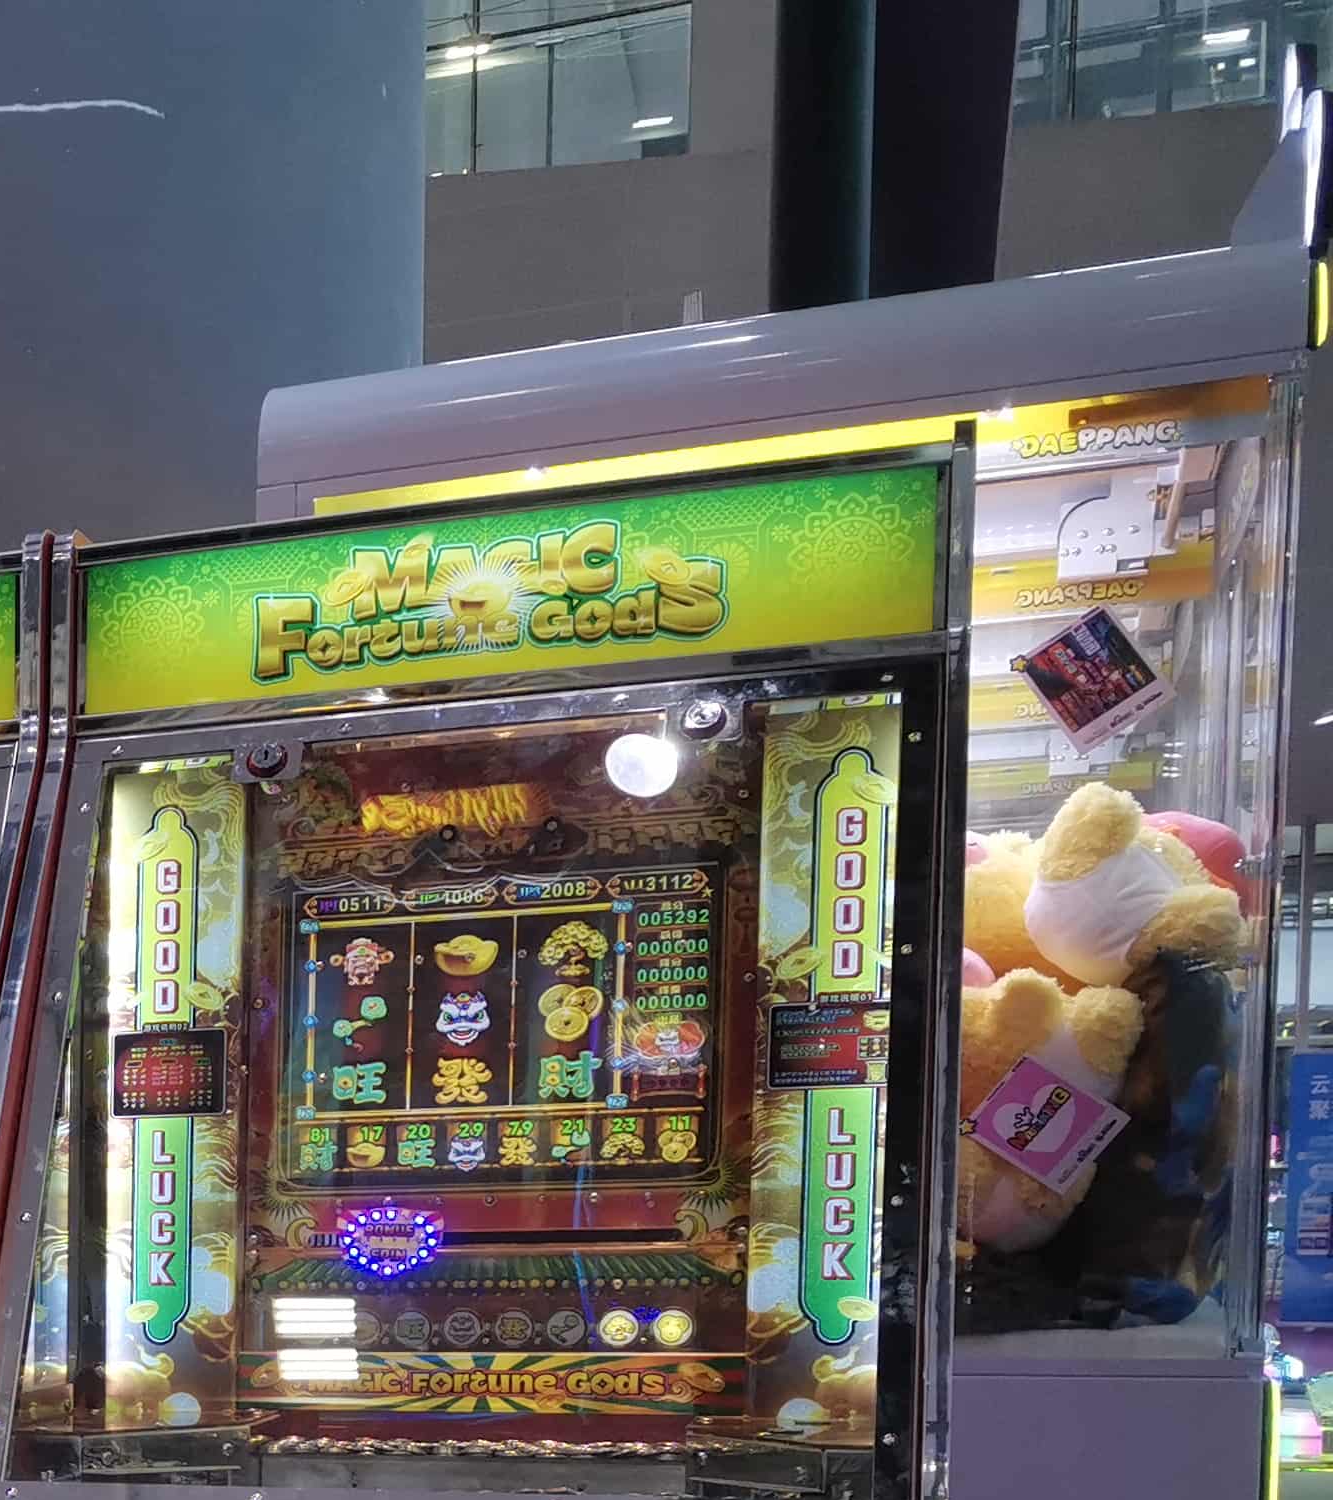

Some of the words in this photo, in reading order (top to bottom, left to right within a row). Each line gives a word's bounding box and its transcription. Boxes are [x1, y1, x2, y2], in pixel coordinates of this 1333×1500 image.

[1019, 421, 1177, 458] DAEPPANG
[541, 880, 586, 898] 2008
[645, 875, 693, 892] 3112
[339, 896, 381, 912] 0511
[638, 909, 709, 927] 005292
[637, 938, 709, 957] 000000
[636, 966, 708, 983] 000000
[636, 993, 707, 1010] 000000
[406, 1124, 432, 1139] 20
[459, 1122, 485, 1137] 29
[508, 1120, 535, 1136] 79
[561, 1119, 587, 1135] 21
[612, 1117, 637, 1132] 23
[668, 1115, 692, 1131] 11
[309, 1127, 331, 1144] 81
[360, 1125, 384, 1140] 17
[820, 1107, 857, 1281] LUCK
[147, 1130, 177, 1290] LUCK
[410, 1369, 559, 1397] Fortune
[566, 1370, 666, 1397] Gods
